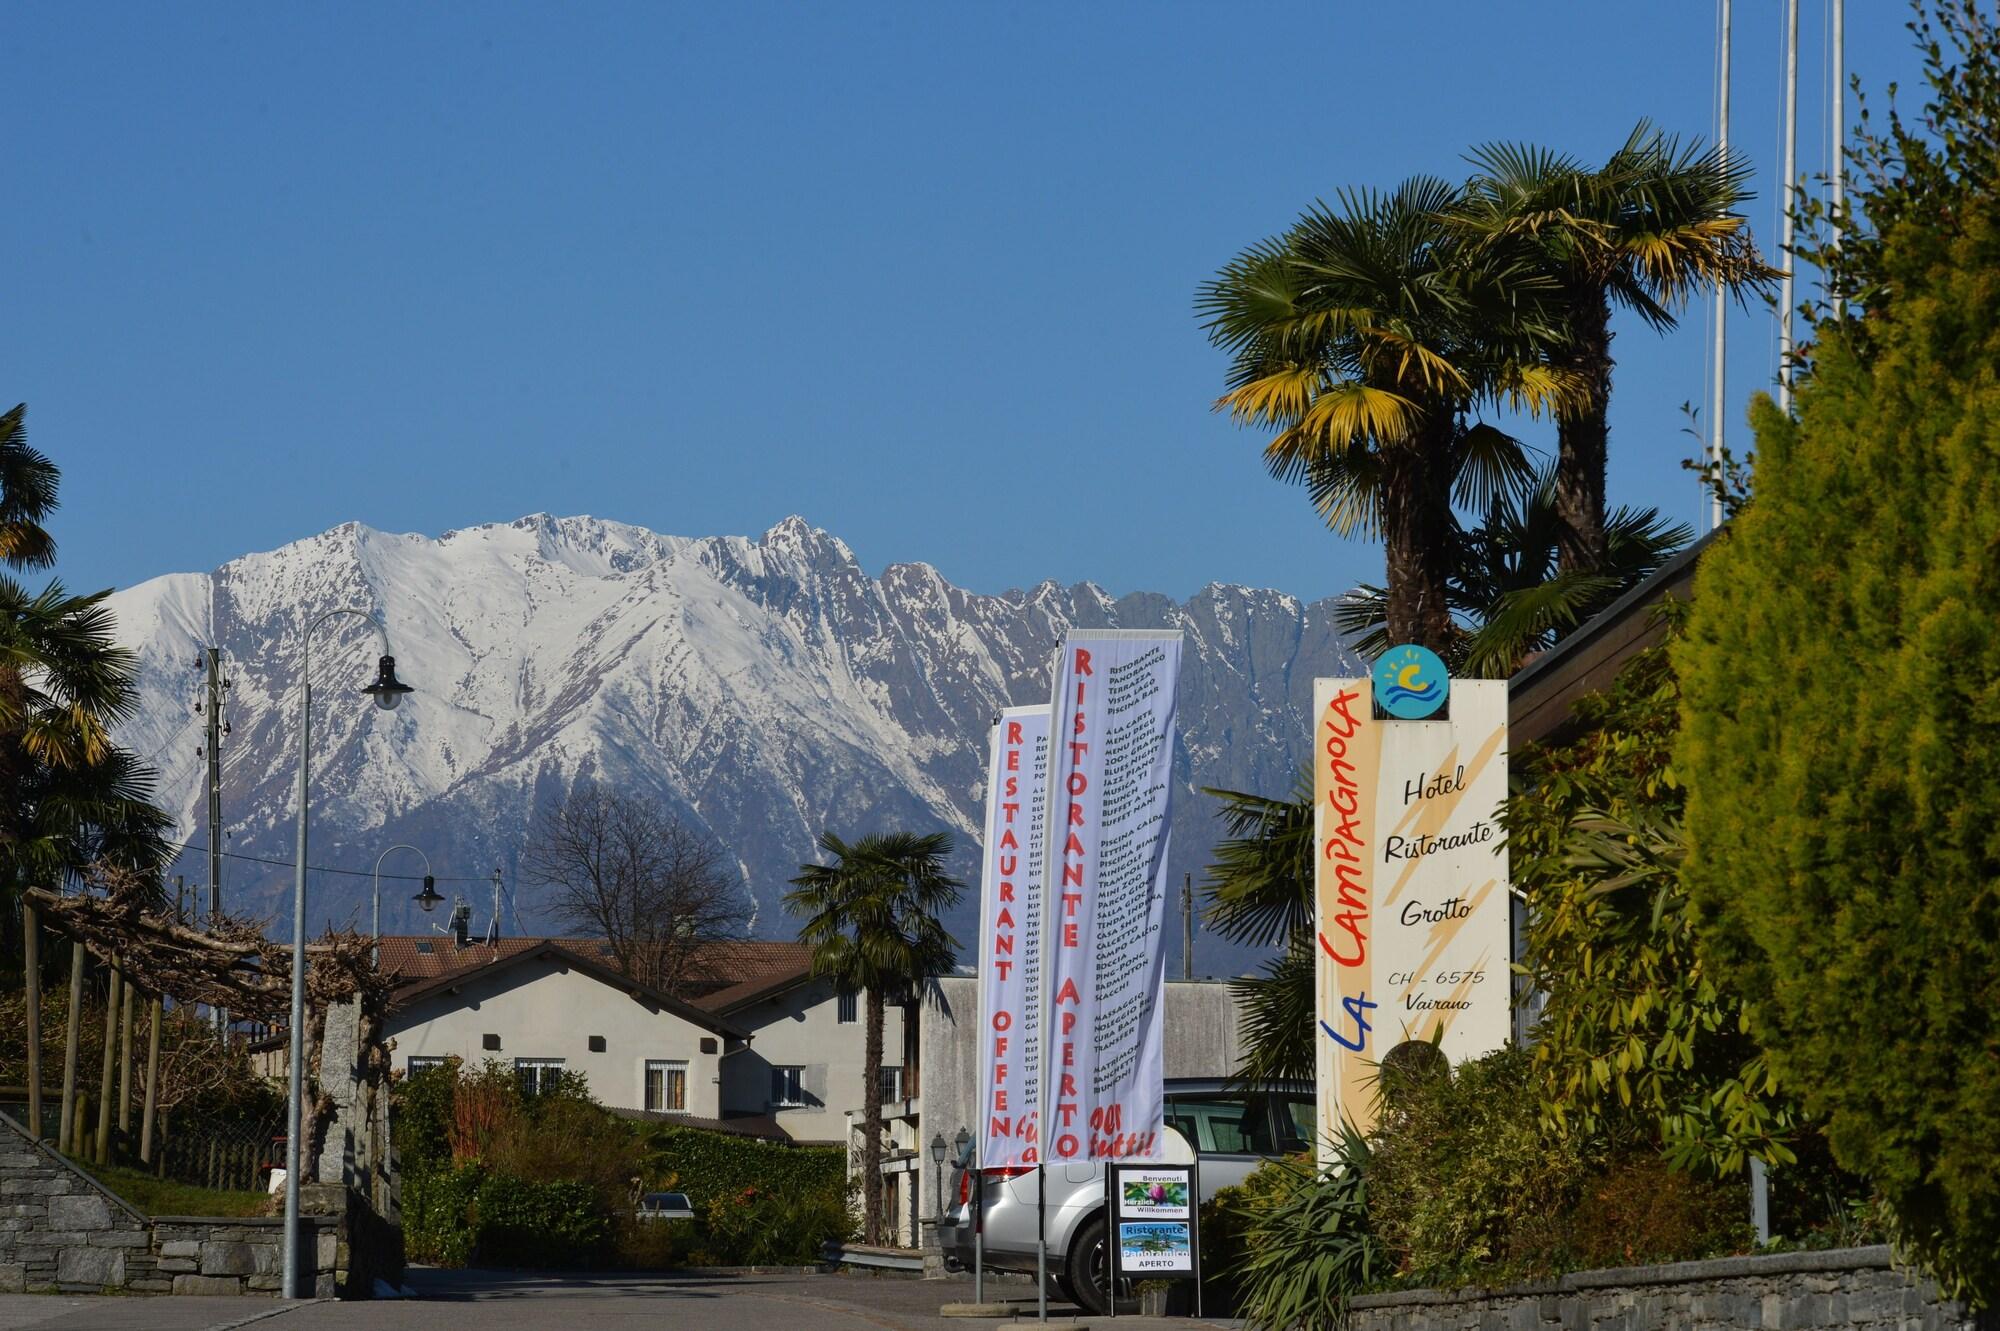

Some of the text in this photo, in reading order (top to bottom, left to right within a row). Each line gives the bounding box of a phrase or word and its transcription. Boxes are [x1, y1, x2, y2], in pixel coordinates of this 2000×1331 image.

[1109, 654, 1166, 684] PANORAMICO
[1110, 646, 1160, 674] RISTORANTE
[1108, 672, 1152, 694] TERRAZZA
[1108, 678, 1155, 705] VISTA LAGO
[1108, 686, 1159, 715] PISCINA BAR
[1114, 726, 1124, 734] LA
[1126, 709, 1152, 729] CARTE
[1105, 728, 1155, 755] MENU FIORI
[1106, 732, 1131, 745] MENU
[1131, 734, 1165, 755] GRAPPA
[1104, 757, 1155, 786] JAZZ PIANO
[1105, 745, 1159, 776] BLUES NIGHT
[1103, 770, 1147, 796] MUSICA TI
[1404, 765, 1467, 805] Hotel
[1103, 787, 1138, 806] BRUNCH
[1103, 800, 1132, 817] BUFFET
[1143, 783, 1166, 797] TEMA
[1102, 796, 1155, 827] BUFFET NANI
[1101, 814, 1164, 847] PISCINA CALDA
[1385, 822, 1493, 863] Ristorante
[1100, 840, 1132, 857] LETTINI
[1100, 850, 1133, 868] PISCINA
[1099, 853, 1143, 878] MINIGOLF
[1098, 873, 1142, 899] MINI ZOO
[1056, 648, 1093, 1158] RISTORANTE APERTO
[1098, 893, 1126, 909] PARCO
[1401, 897, 1473, 926] Grotto
[991, 722, 1024, 1137] RESTAURANT OFFEN
[1097, 915, 1125, 929] TENDA
[1097, 929, 1118, 940] CASA
[1096, 925, 1138, 950] CALCETTO
[1096, 943, 1127, 960] CAMPO
[1096, 953, 1127, 970] BOCCIA
[1096, 952, 1145, 981] PING-PONG
[1096, 959, 1149, 991] BADMINTON
[1388, 971, 1414, 985] CH
[1436, 971, 1486, 984] 6575
[1095, 981, 1129, 1001] SCACCHI
[1406, 993, 1472, 1010] Vairano
[1094, 991, 1144, 1022] MASSAGGIO
[1094, 1006, 1136, 1032] NOLEGGIO
[1319, 991, 1378, 1051] LA
[1094, 1030, 1115, 1042] CURA
[1094, 1027, 1134, 1053] TRANSFER
[1089, 1132, 1156, 1158] tutti!
[1126, 1226, 1184, 1234] Ristorante
[1139, 1260, 1174, 1268] APERTO
